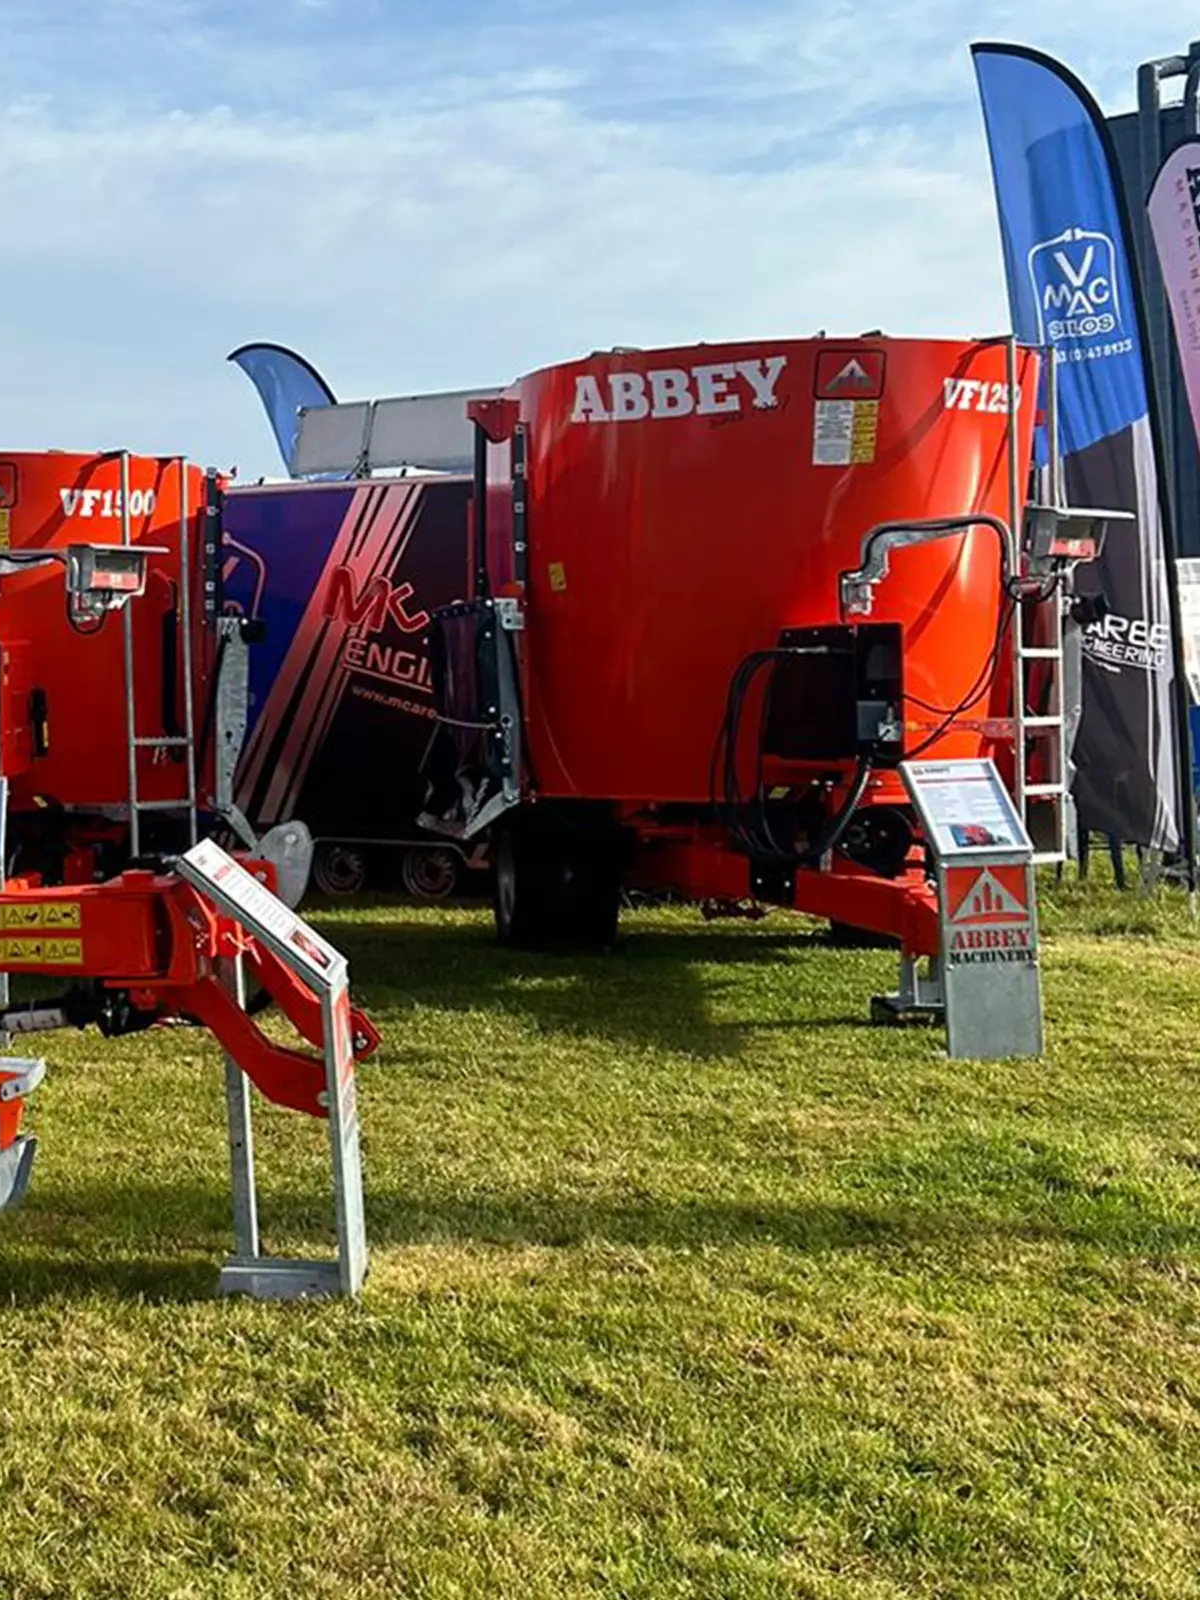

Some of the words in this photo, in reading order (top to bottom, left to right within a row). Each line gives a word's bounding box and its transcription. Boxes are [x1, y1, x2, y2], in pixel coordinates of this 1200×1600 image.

[1048, 313, 1115, 340] SILOS
[570, 356, 787, 423] ABBEY
[344, 638, 432, 686] ENGI
[950, 928, 1031, 950] ABBEY
[950, 949, 1037, 965] MACHINERY
